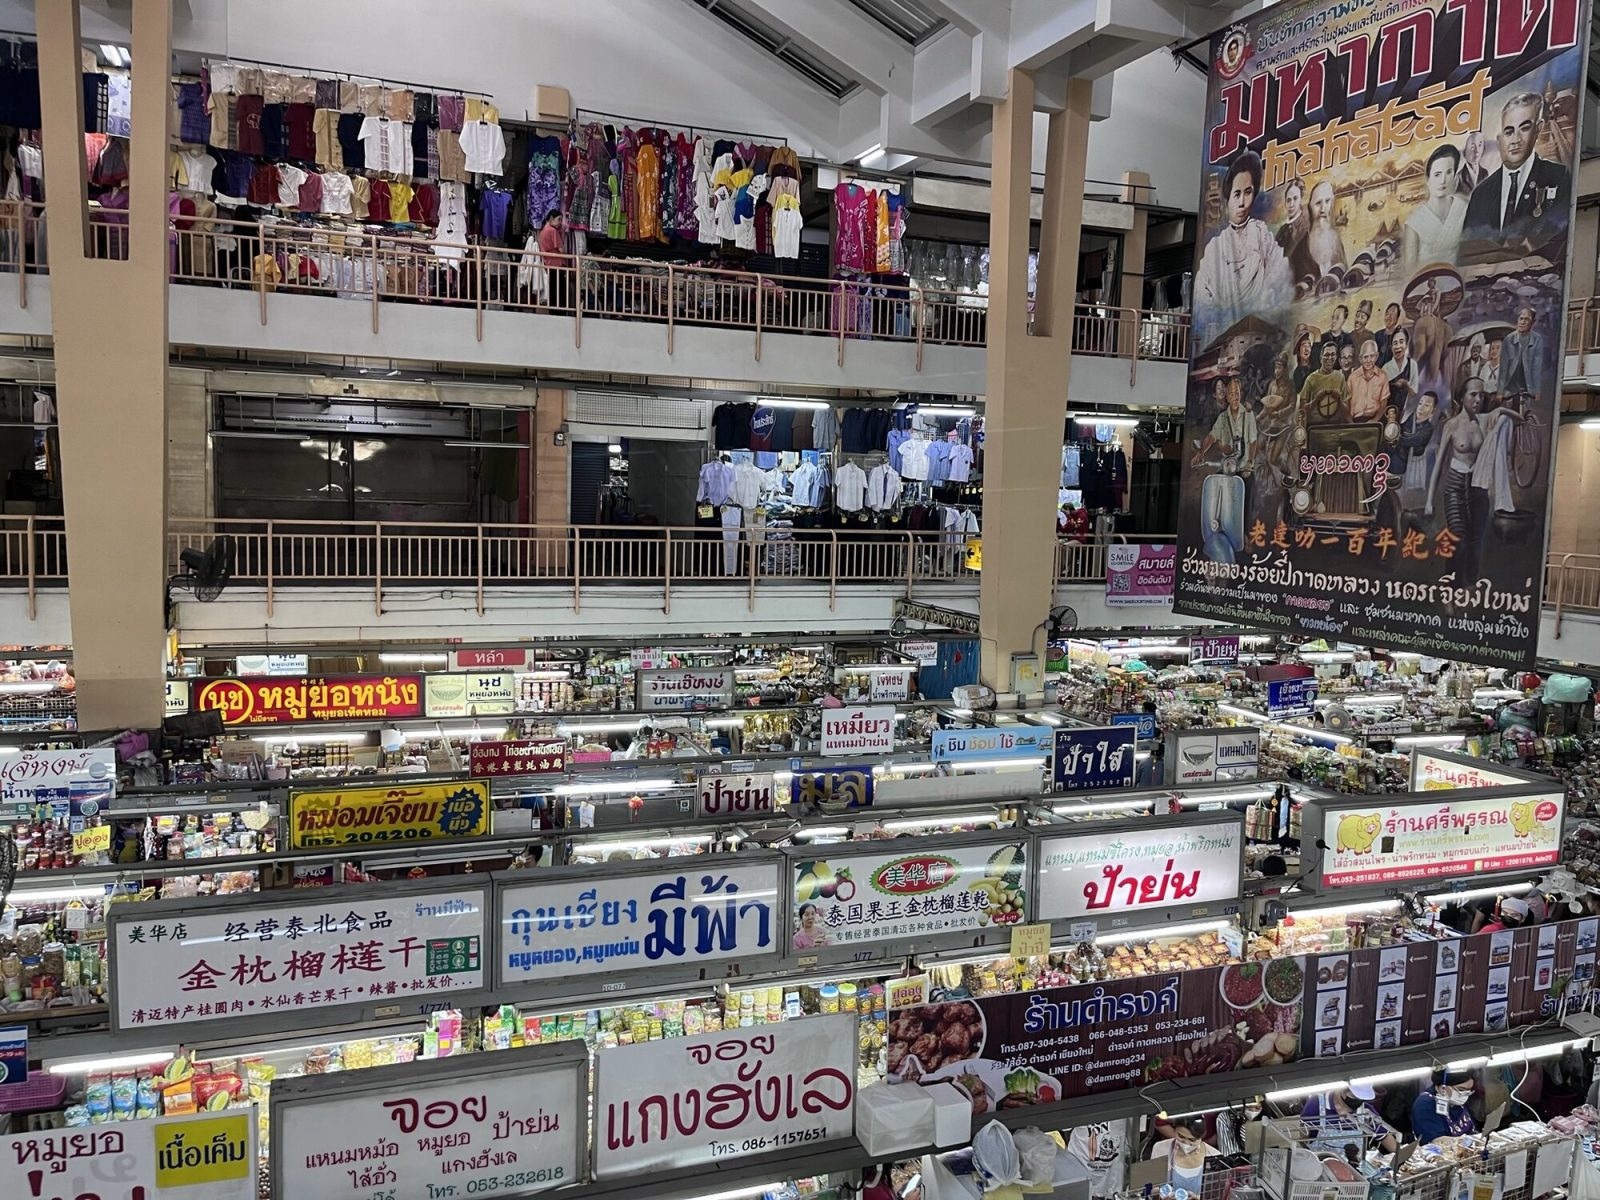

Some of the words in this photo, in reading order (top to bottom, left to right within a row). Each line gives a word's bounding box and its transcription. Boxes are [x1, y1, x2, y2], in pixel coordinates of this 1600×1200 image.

[259, 677, 418, 719] หมูยอหนัง
[826, 712, 890, 736] เหมียว
[702, 778, 770, 814] ป้าย่น
[345, 828, 432, 844] 204206
[1384, 806, 1508, 834] ร้านศรีพรรณ
[1083, 859, 1201, 910] ป้าย่น
[128, 922, 189, 945] 美华店
[224, 909, 394, 943] 经营泰北食品
[511, 889, 638, 945] กุนเชียง
[644, 875, 771, 960] มีฟ้า
[1024, 978, 1179, 1034] ร้านดำรงค์
[687, 1034, 775, 1065] จอย
[1000, 1034, 1079, 1054] โทร.087-304-5438
[1088, 1024, 1148, 1041] 066-048-5353
[1155, 1016, 1205, 1030] 053-234-661
[1049, 1065, 1070, 1077] LINE
[1072, 1063, 1084, 1074] ID:
[1085, 1053, 1146, 1072] @damrong234
[1085, 1068, 1141, 1087] @damrong88
[383, 1095, 487, 1134] จอย
[607, 1059, 853, 1151] แกงฮังเล
[12, 1130, 124, 1174] หมูยอ
[159, 1133, 246, 1170] เนื้อเค็ม
[305, 1138, 400, 1169] แหนมหม้อ
[417, 1131, 471, 1158] หมูยอ
[493, 1109, 560, 1141] ป้าย่น
[742, 1127, 828, 1152] 086-1157651
[348, 1161, 398, 1190] ไส้อั่ว
[441, 1148, 518, 1175] แกงฮังเล
[467, 1166, 565, 1194] 053-232618
